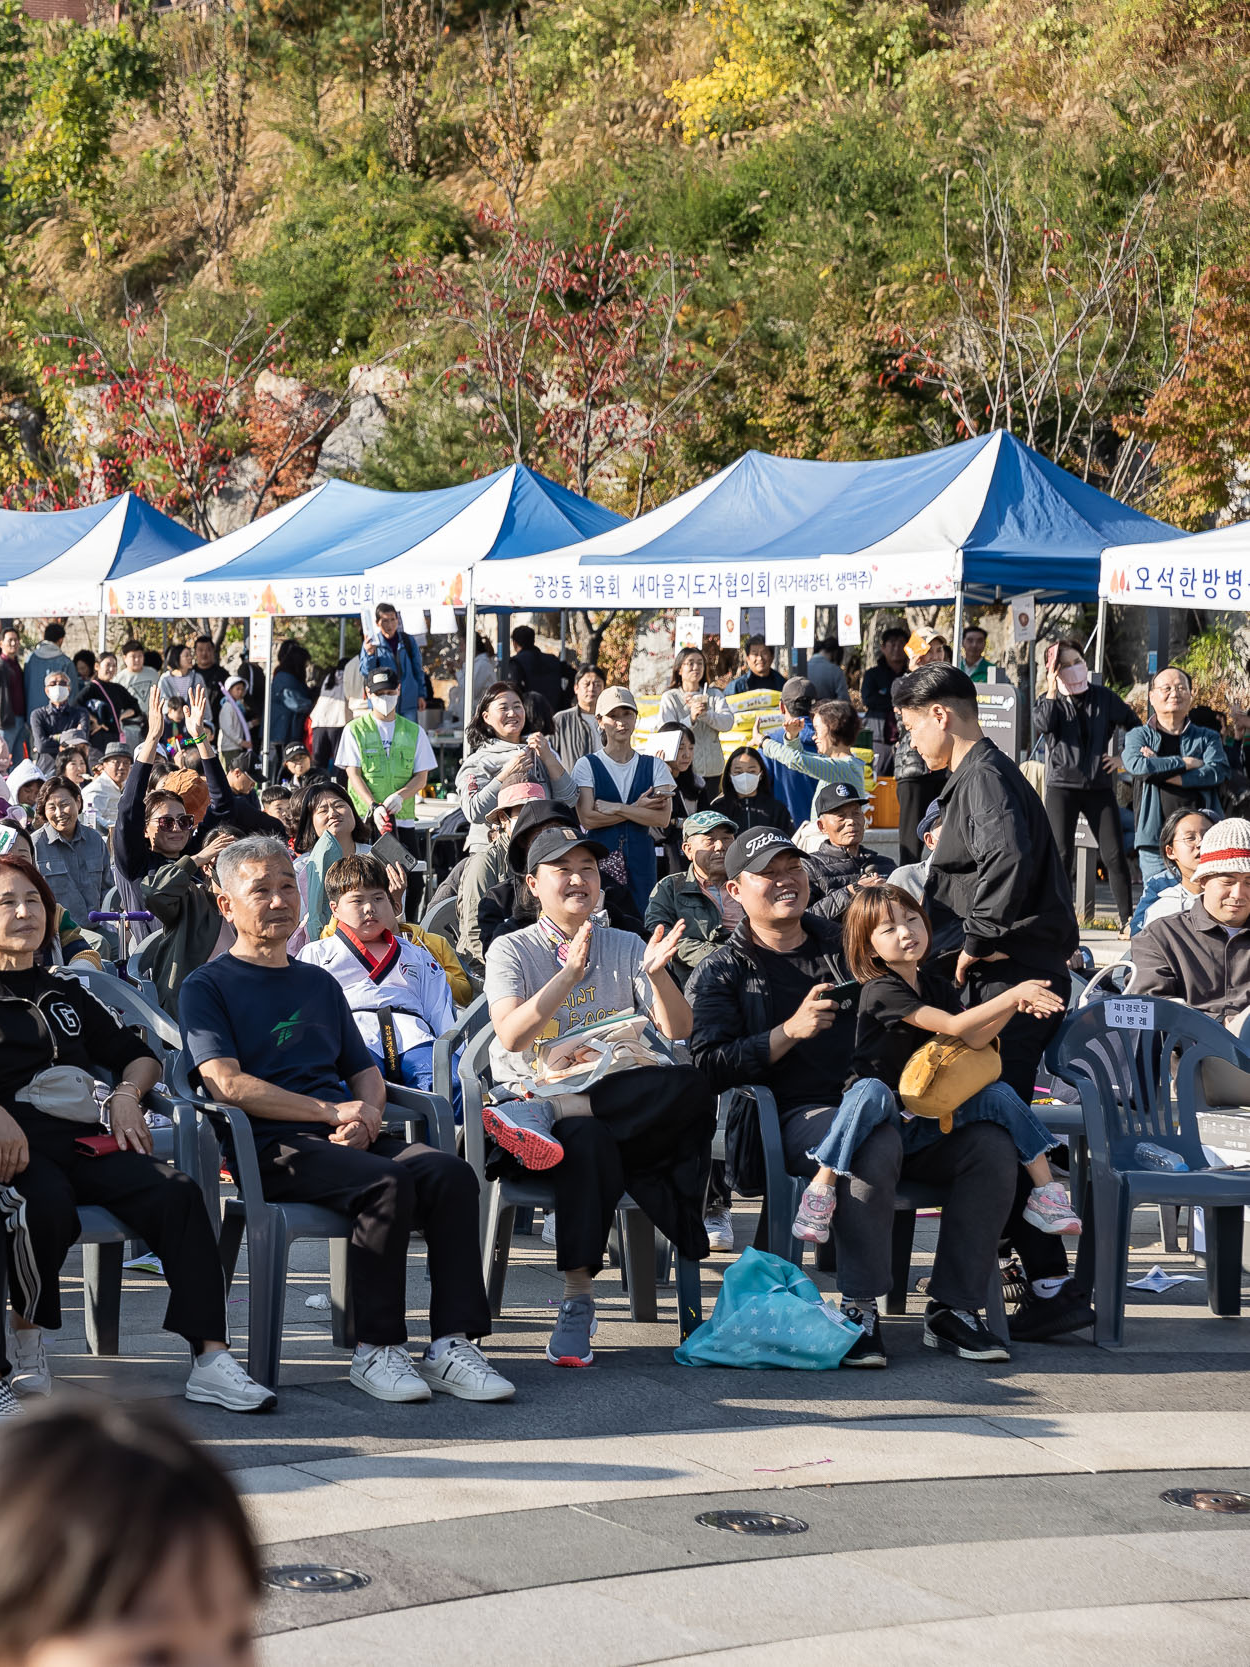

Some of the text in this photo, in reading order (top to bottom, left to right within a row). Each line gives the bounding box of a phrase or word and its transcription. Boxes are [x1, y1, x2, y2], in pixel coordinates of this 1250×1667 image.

[294, 585, 330, 608] 광장동
[337, 584, 374, 606] 상인회
[533, 575, 573, 599] 광장동
[579, 574, 620, 598] 체육회
[632, 571, 770, 598] 새마을지도자협의회
[1135, 567, 1250, 600] 오석한방병
[1114, 1003, 1148, 1014] 제1경로당
